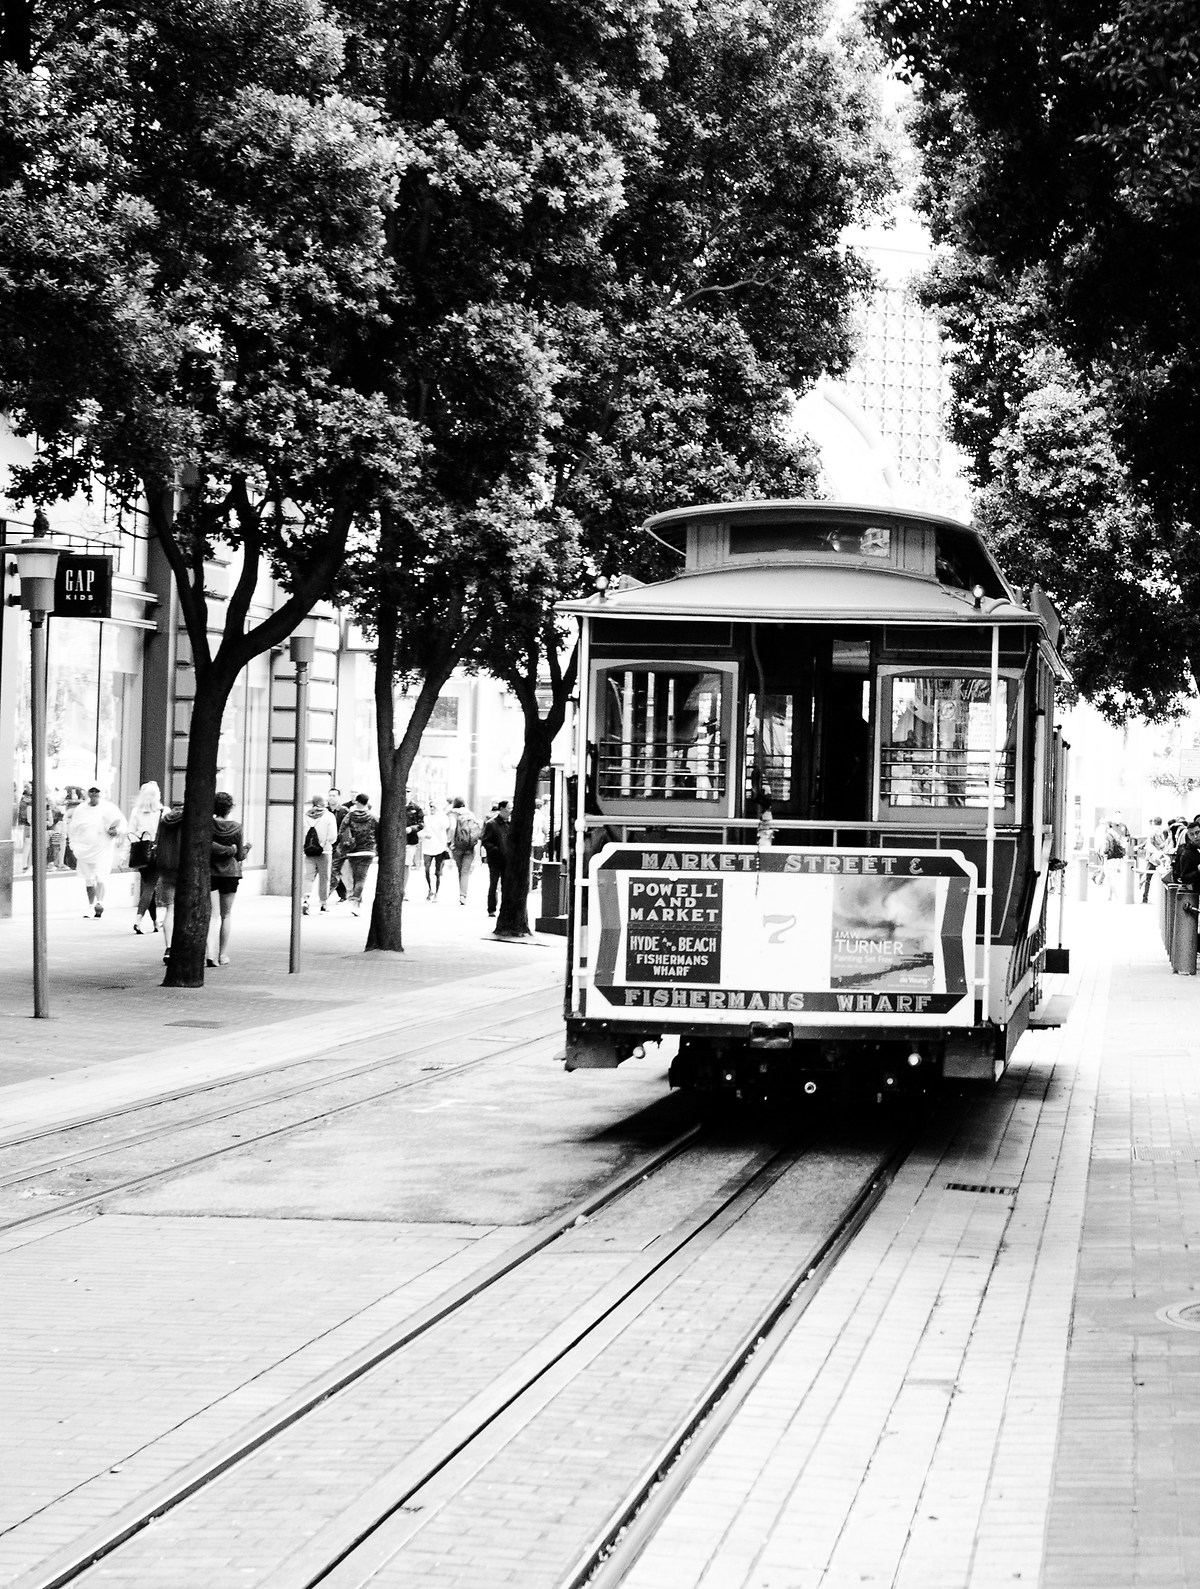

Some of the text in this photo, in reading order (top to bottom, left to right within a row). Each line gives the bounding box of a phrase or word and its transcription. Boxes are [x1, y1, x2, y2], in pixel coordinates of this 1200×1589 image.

[65, 569, 95, 591] GAP
[641, 851, 924, 875] MARKET STREET &
[632, 883, 719, 898] POWELL
[654, 897, 698, 908] AND
[630, 908, 719, 922] MARKET
[762, 914, 797, 944] 7
[630, 936, 660, 951] HYDE
[678, 937, 717, 953] BEACH
[834, 940, 905, 955] TURNER
[636, 954, 709, 966] FISHERMANS
[653, 966, 691, 976] WHARF
[624, 988, 932, 1013] FISHERMANS WHARF
